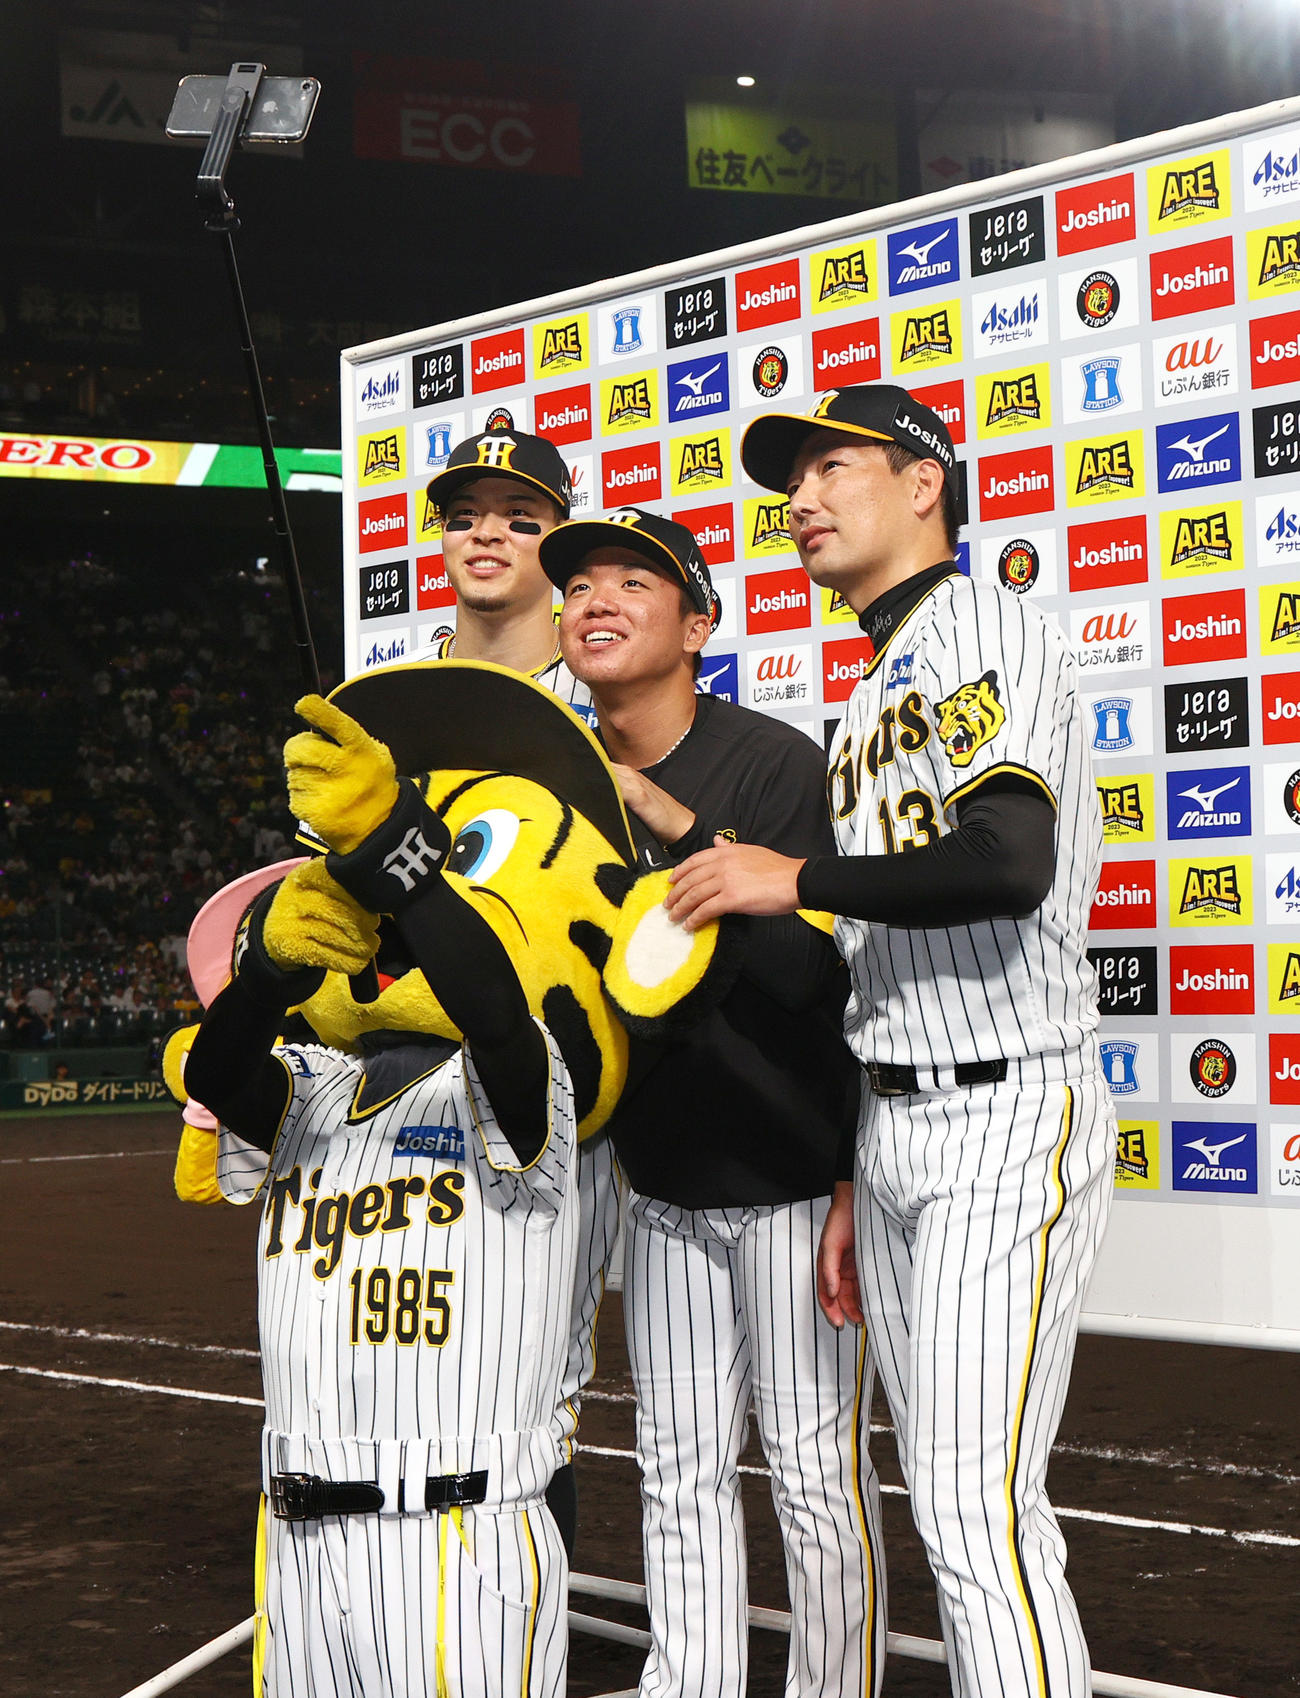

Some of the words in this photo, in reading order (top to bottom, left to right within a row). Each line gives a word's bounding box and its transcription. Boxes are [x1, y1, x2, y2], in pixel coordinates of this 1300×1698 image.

[401, 108, 536, 167] ECC
[1253, 149, 1300, 186] Asa
[1062, 200, 1130, 232] Joshin
[981, 233, 1034, 266] セ・リーグ
[1080, 273, 1115, 293] HANSHIN
[1156, 264, 1228, 296] Joshin
[740, 282, 796, 310] Joshin
[674, 310, 719, 339] セ・リーグ
[981, 293, 1038, 335] Asahi
[1084, 310, 1114, 327] Tigers
[989, 329, 1033, 345] アサヒビール
[475, 350, 521, 374] Joshin
[755, 348, 784, 366] HANSHIN
[818, 342, 876, 370] Joshin
[1166, 338, 1222, 371] au
[1083, 360, 1119, 375] LAWSON
[361, 371, 399, 401] Asahi
[419, 374, 457, 400] セ・リーグ
[1162, 369, 1229, 396] じぶん銀行
[1085, 396, 1119, 410] STATION
[539, 405, 587, 430] Joshin
[895, 415, 953, 468] Joshin
[606, 464, 657, 488] Joshin
[984, 470, 1049, 498] Joshin
[362, 513, 404, 535] Joshin
[696, 525, 730, 546] shin
[1266, 506, 1300, 541] As
[1002, 541, 1034, 559] HANSHIN
[1074, 540, 1142, 568] Joshin
[366, 589, 403, 612] セ・リーグ
[750, 589, 806, 613] Joshin
[1083, 613, 1136, 643] au
[1168, 614, 1240, 642] Joshin
[366, 639, 404, 666] Asahi
[1079, 645, 1143, 666] じぶん銀行
[757, 654, 801, 681] au
[754, 684, 806, 702] じぶん銀行
[1095, 700, 1129, 712] LAWSON
[1176, 715, 1237, 744] セ・リーグ
[1096, 737, 1130, 749] STATION
[878, 788, 942, 854] 13
[1095, 884, 1151, 906] oshin
[1176, 969, 1248, 990] Joshin
[1101, 984, 1147, 1006] ・リーグ
[1100, 1044, 1136, 1056] LAWSON
[1194, 1041, 1231, 1058] HANSHIN
[25, 1082, 78, 1107] DyDo
[1197, 1080, 1230, 1096] Tigers
[266, 1164, 465, 1281] Tigers
[349, 1267, 454, 1347] 1985
